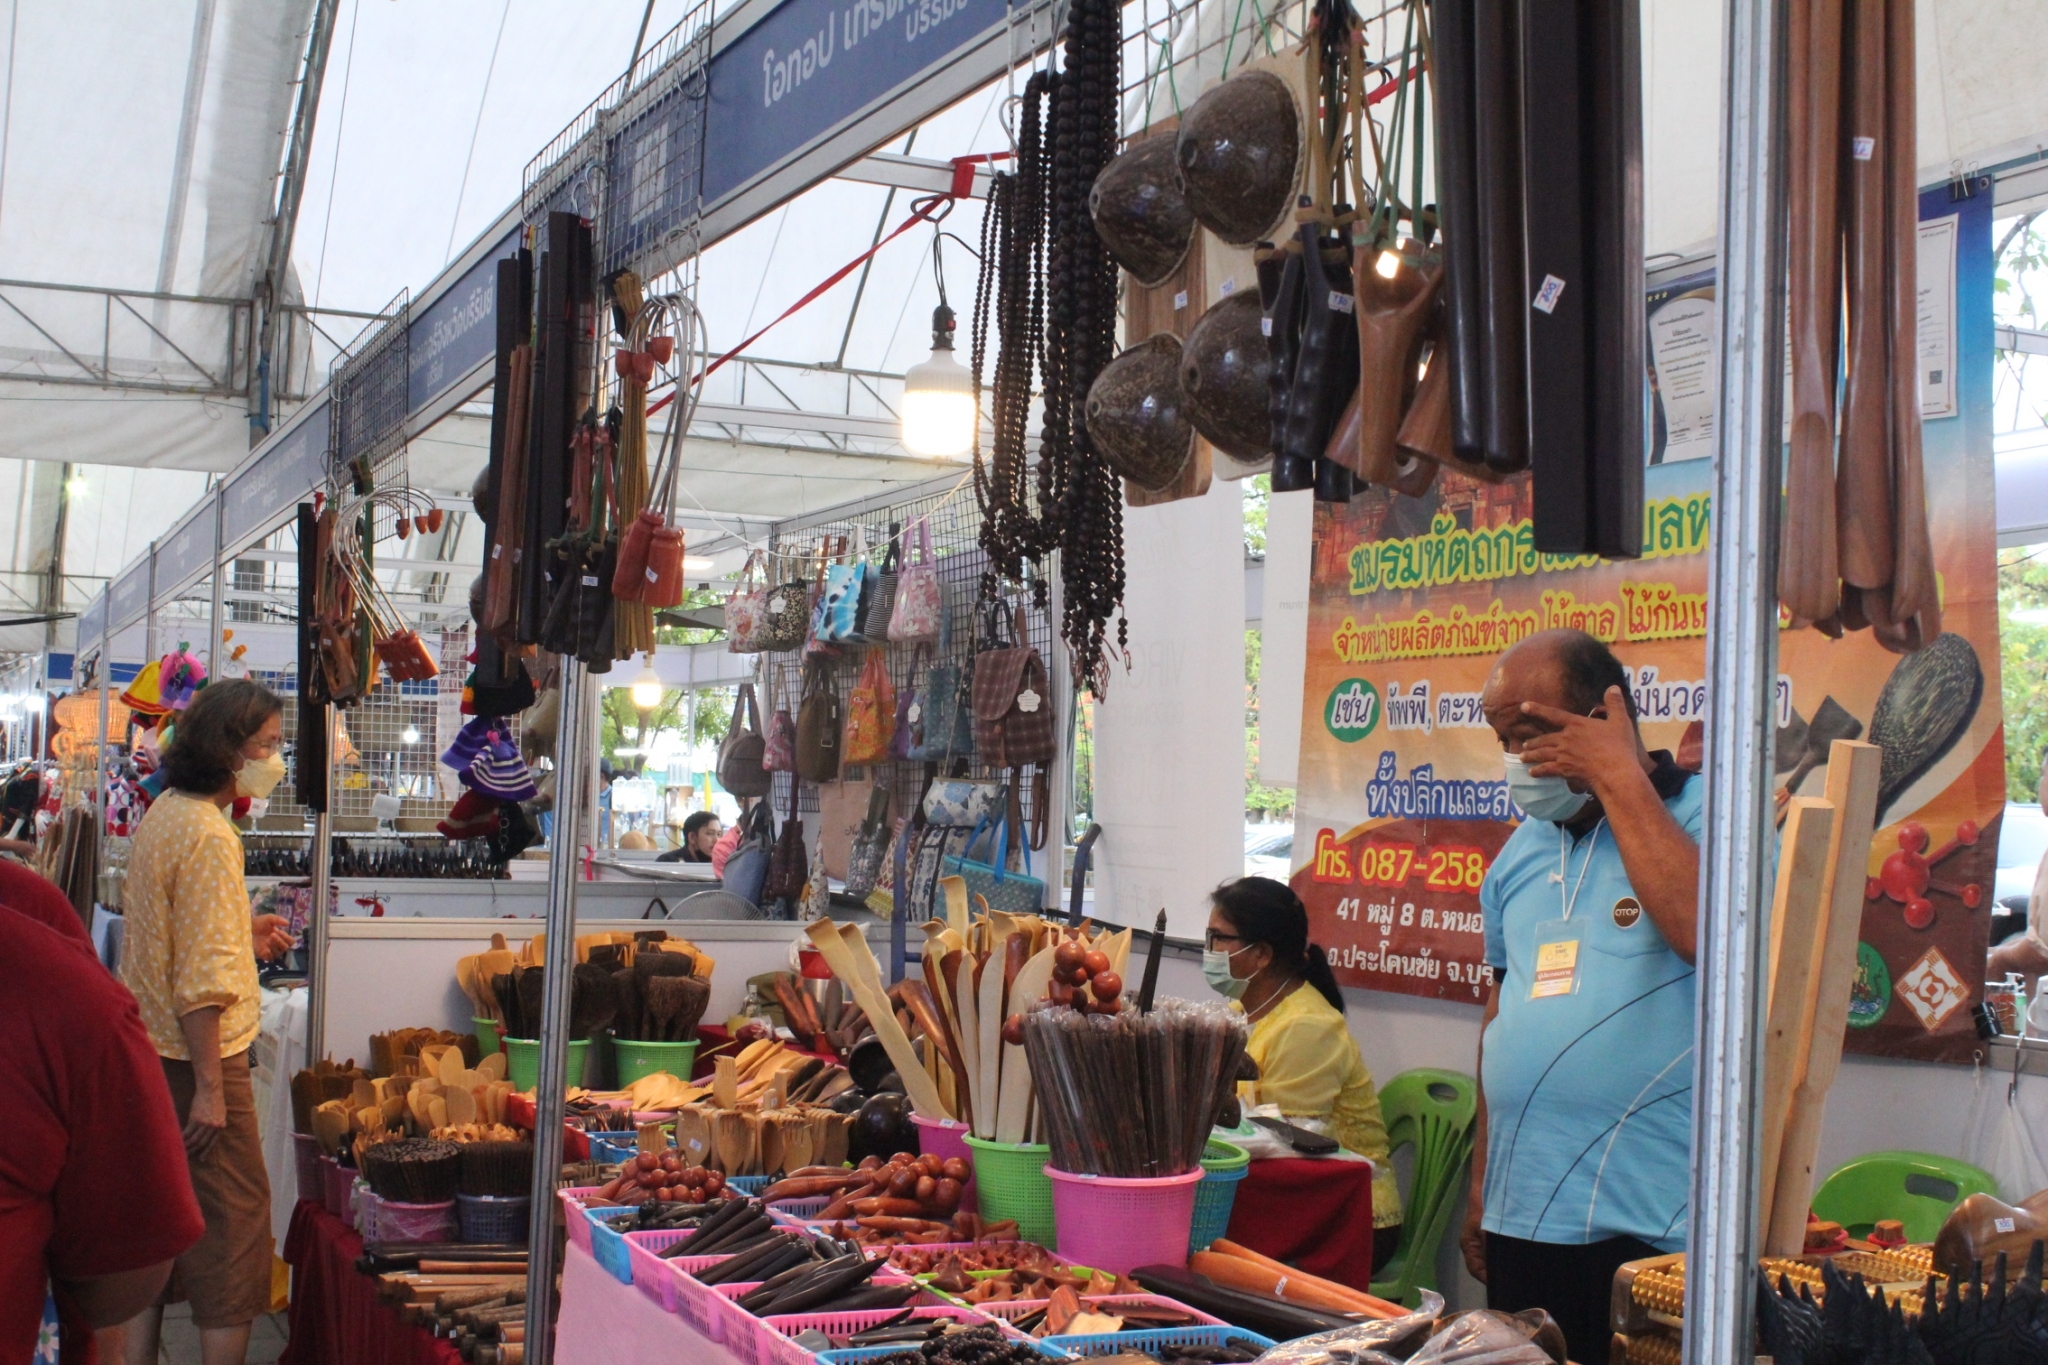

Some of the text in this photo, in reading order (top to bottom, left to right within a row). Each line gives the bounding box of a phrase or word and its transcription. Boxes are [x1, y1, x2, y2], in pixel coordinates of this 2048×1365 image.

[762, 11, 835, 108] โอทอป
[1336, 605, 1536, 657] จำหน่ายผลิตภัณฑ์จาก
[1333, 687, 1372, 724] เช่น
[1386, 684, 1433, 731] ทัพพี,
[1438, 697, 1484, 724] ตะห
[1368, 755, 1525, 817] ทั้งปลีกและส
[1315, 834, 1489, 888] โทร. 087-258
[1336, 896, 1484, 936] 41 หมู่ 8 ต.หนอ
[1614, 907, 1639, 918] OTOP
[1327, 939, 1494, 998] อ.ประโคนชัย จ.บุร
